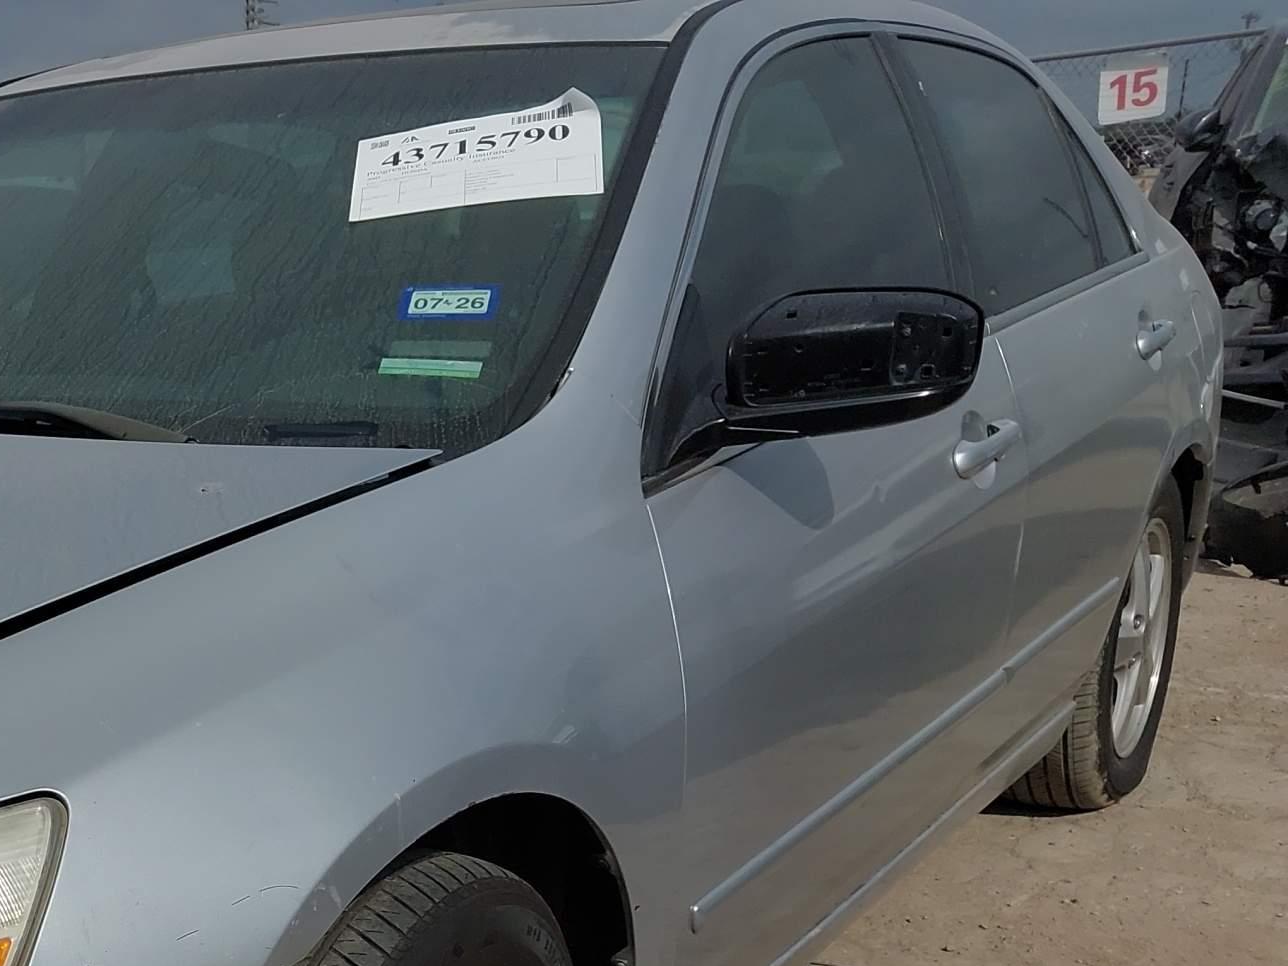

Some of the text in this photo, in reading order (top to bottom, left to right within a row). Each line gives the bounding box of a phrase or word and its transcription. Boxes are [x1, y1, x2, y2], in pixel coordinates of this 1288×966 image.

[1108, 67, 1159, 111] 15
[381, 124, 570, 166] 43715790
[414, 297, 485, 310] 07 26
